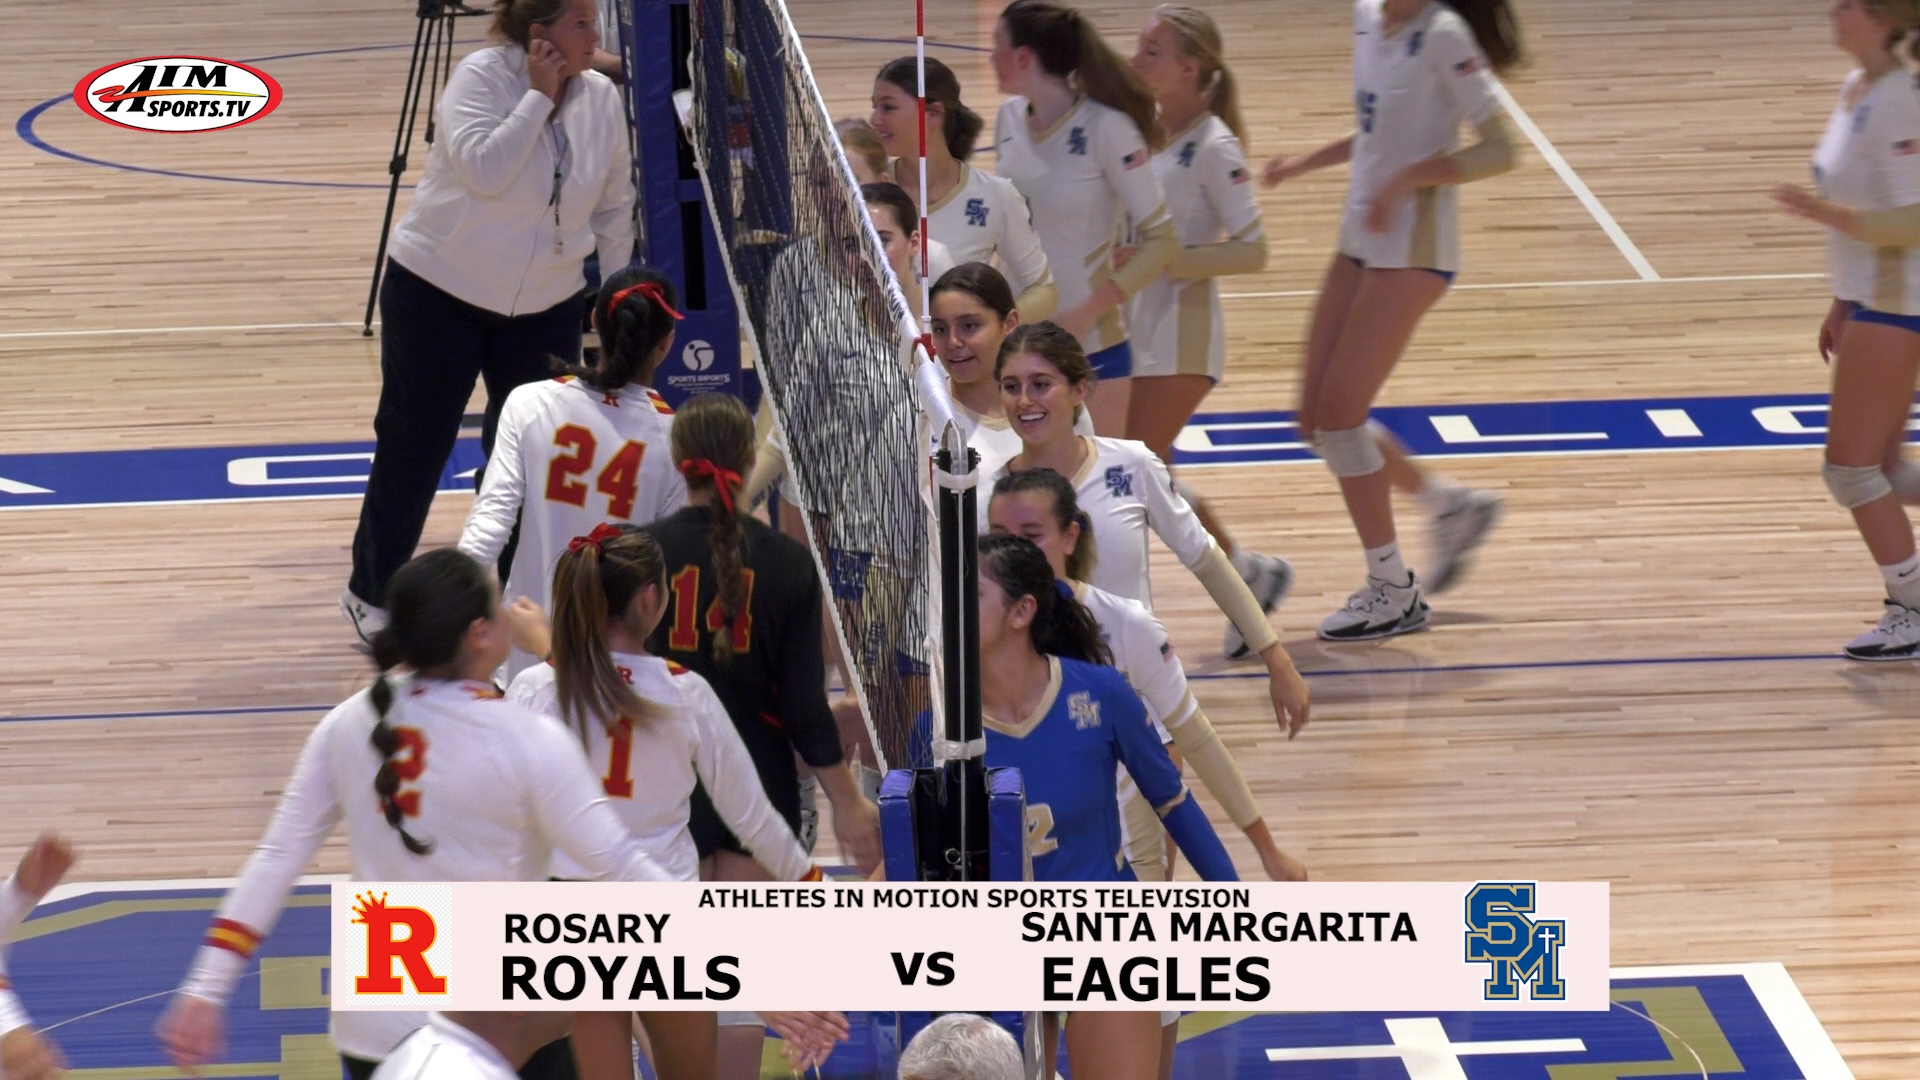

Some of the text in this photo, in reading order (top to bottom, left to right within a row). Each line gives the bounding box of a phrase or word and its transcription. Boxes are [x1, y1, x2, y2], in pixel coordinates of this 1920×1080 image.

[964, 198, 989, 227] SM
[544, 422, 647, 520] 24
[1104, 464, 1133, 497] SM
[1067, 690, 1102, 730] SM
[380, 724, 429, 819] 2
[602, 716, 634, 799] 1
